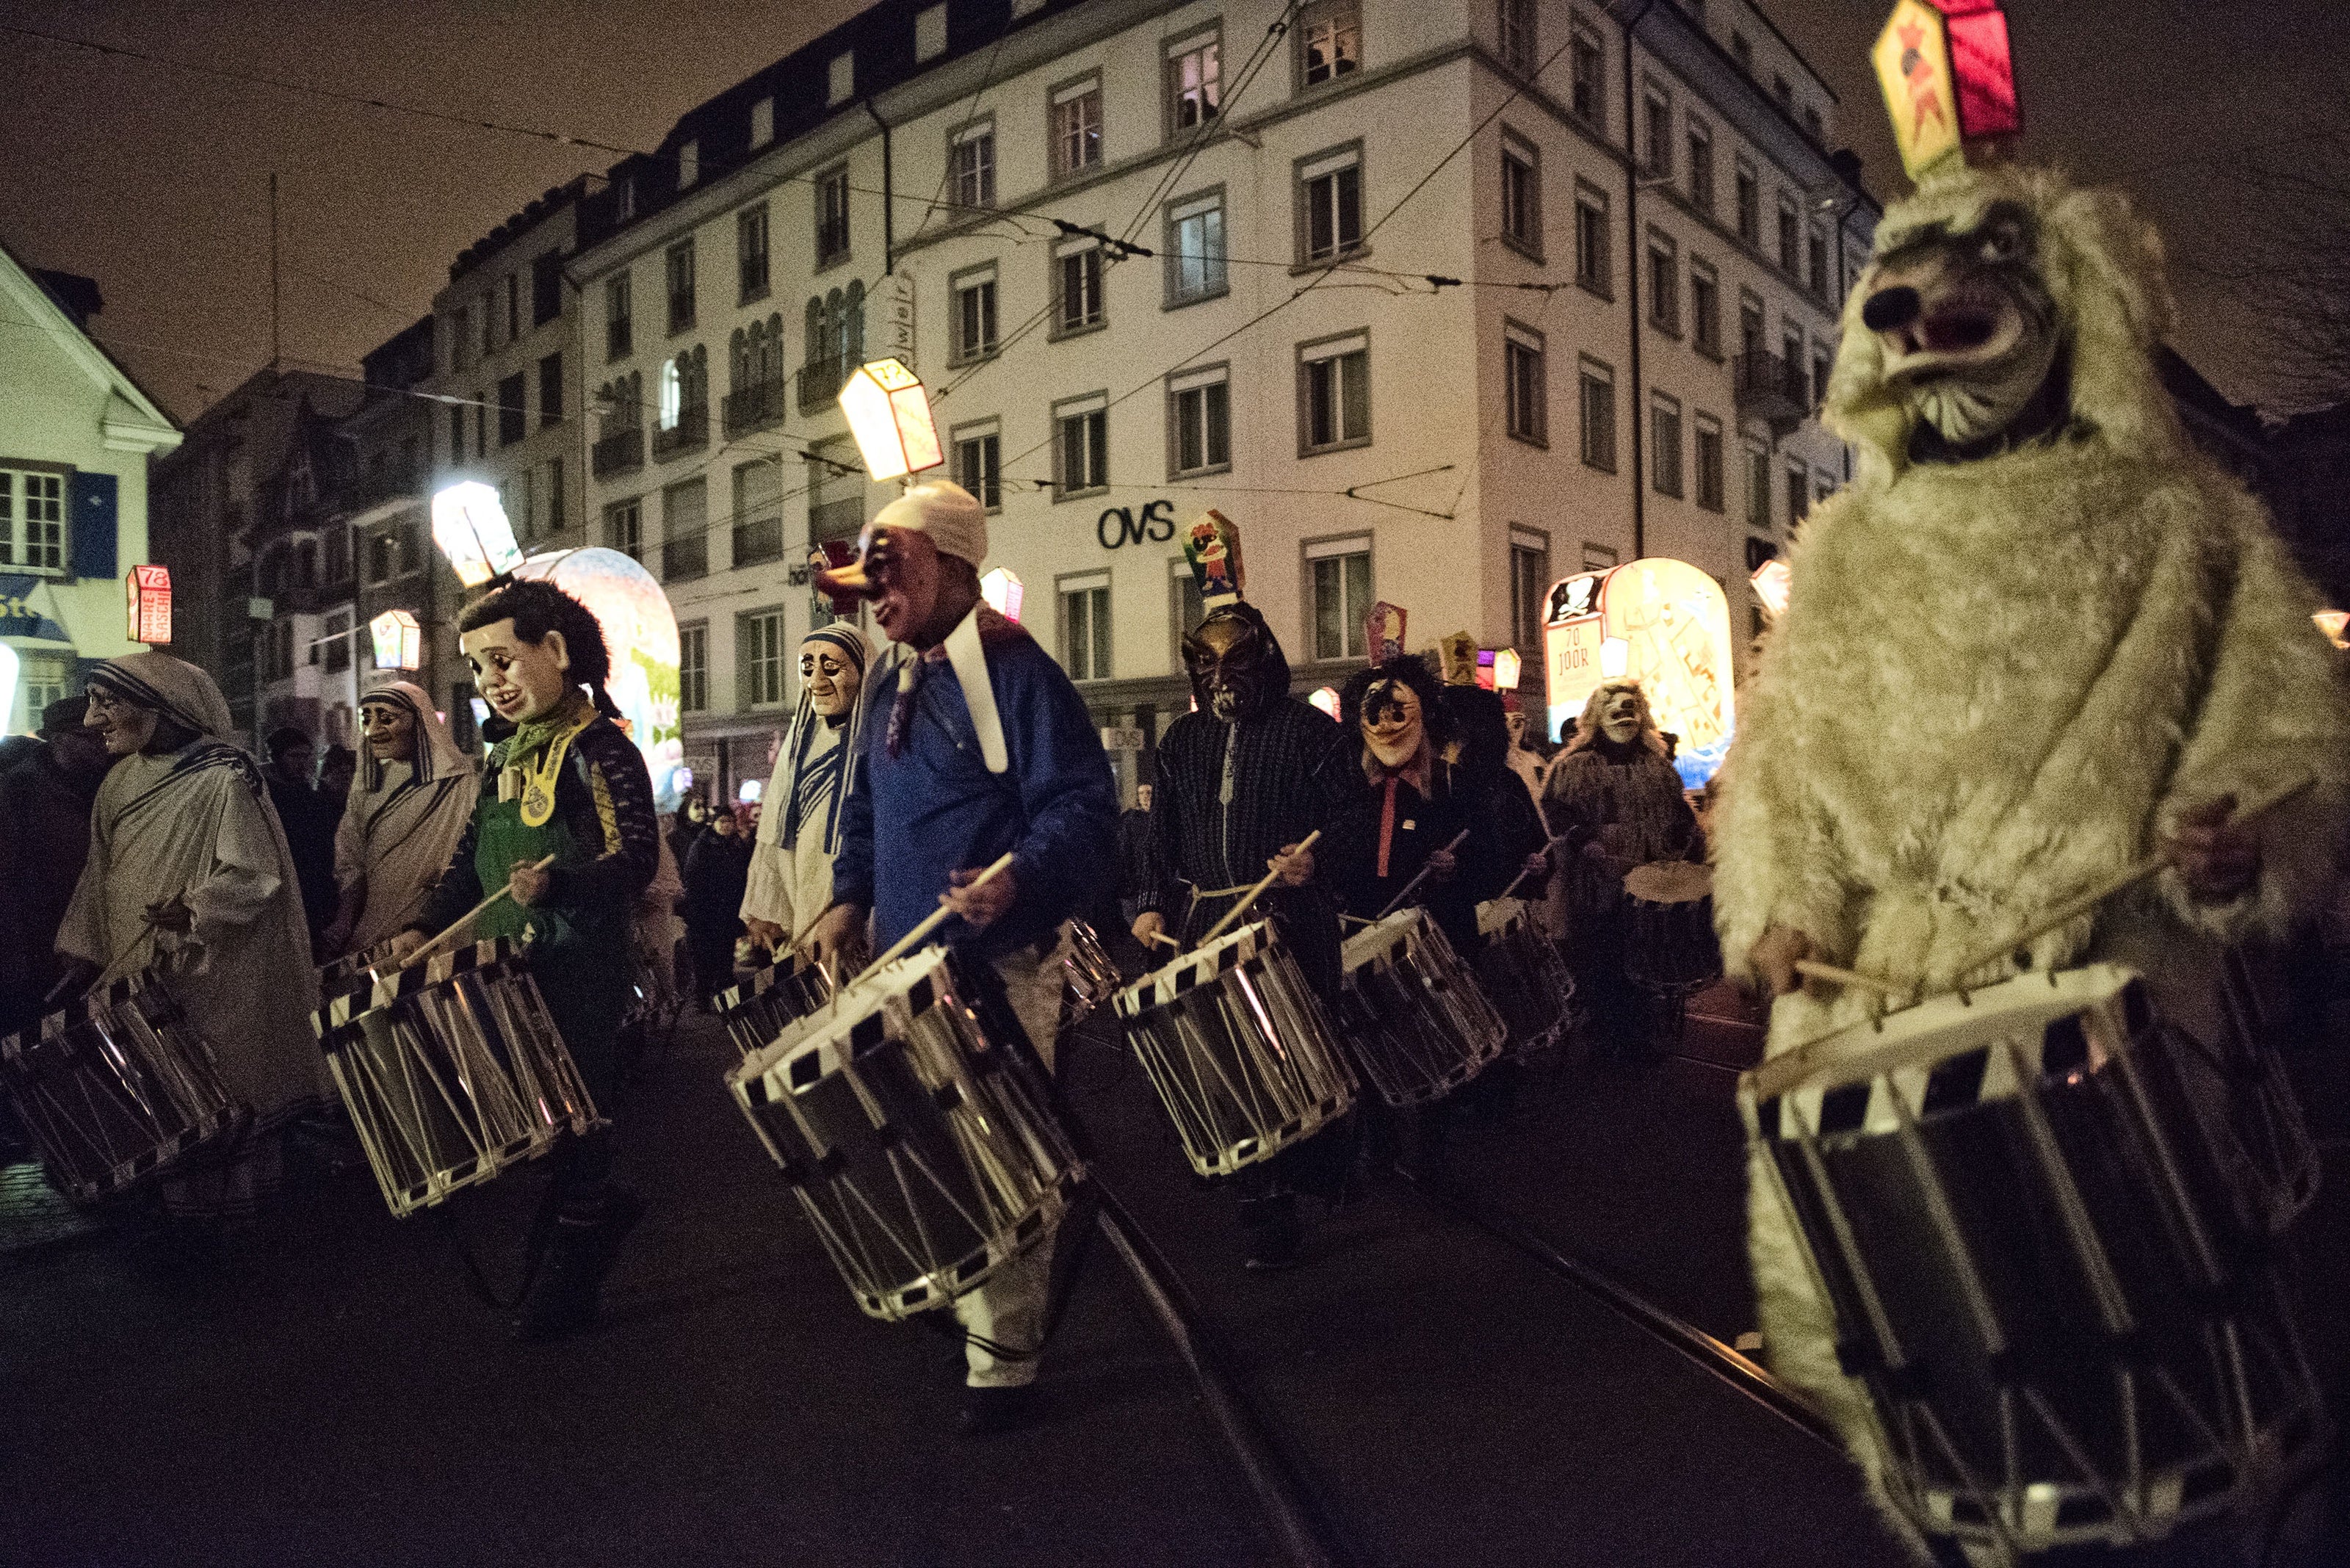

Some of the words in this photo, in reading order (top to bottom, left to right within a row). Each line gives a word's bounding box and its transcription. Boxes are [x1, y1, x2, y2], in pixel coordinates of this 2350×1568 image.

[1098, 499, 1176, 549] OVS
[139, 568, 168, 587] 78
[156, 591, 170, 640] BASCHI
[1566, 627, 1580, 647] 70
[1558, 648, 1589, 676] JOOR
